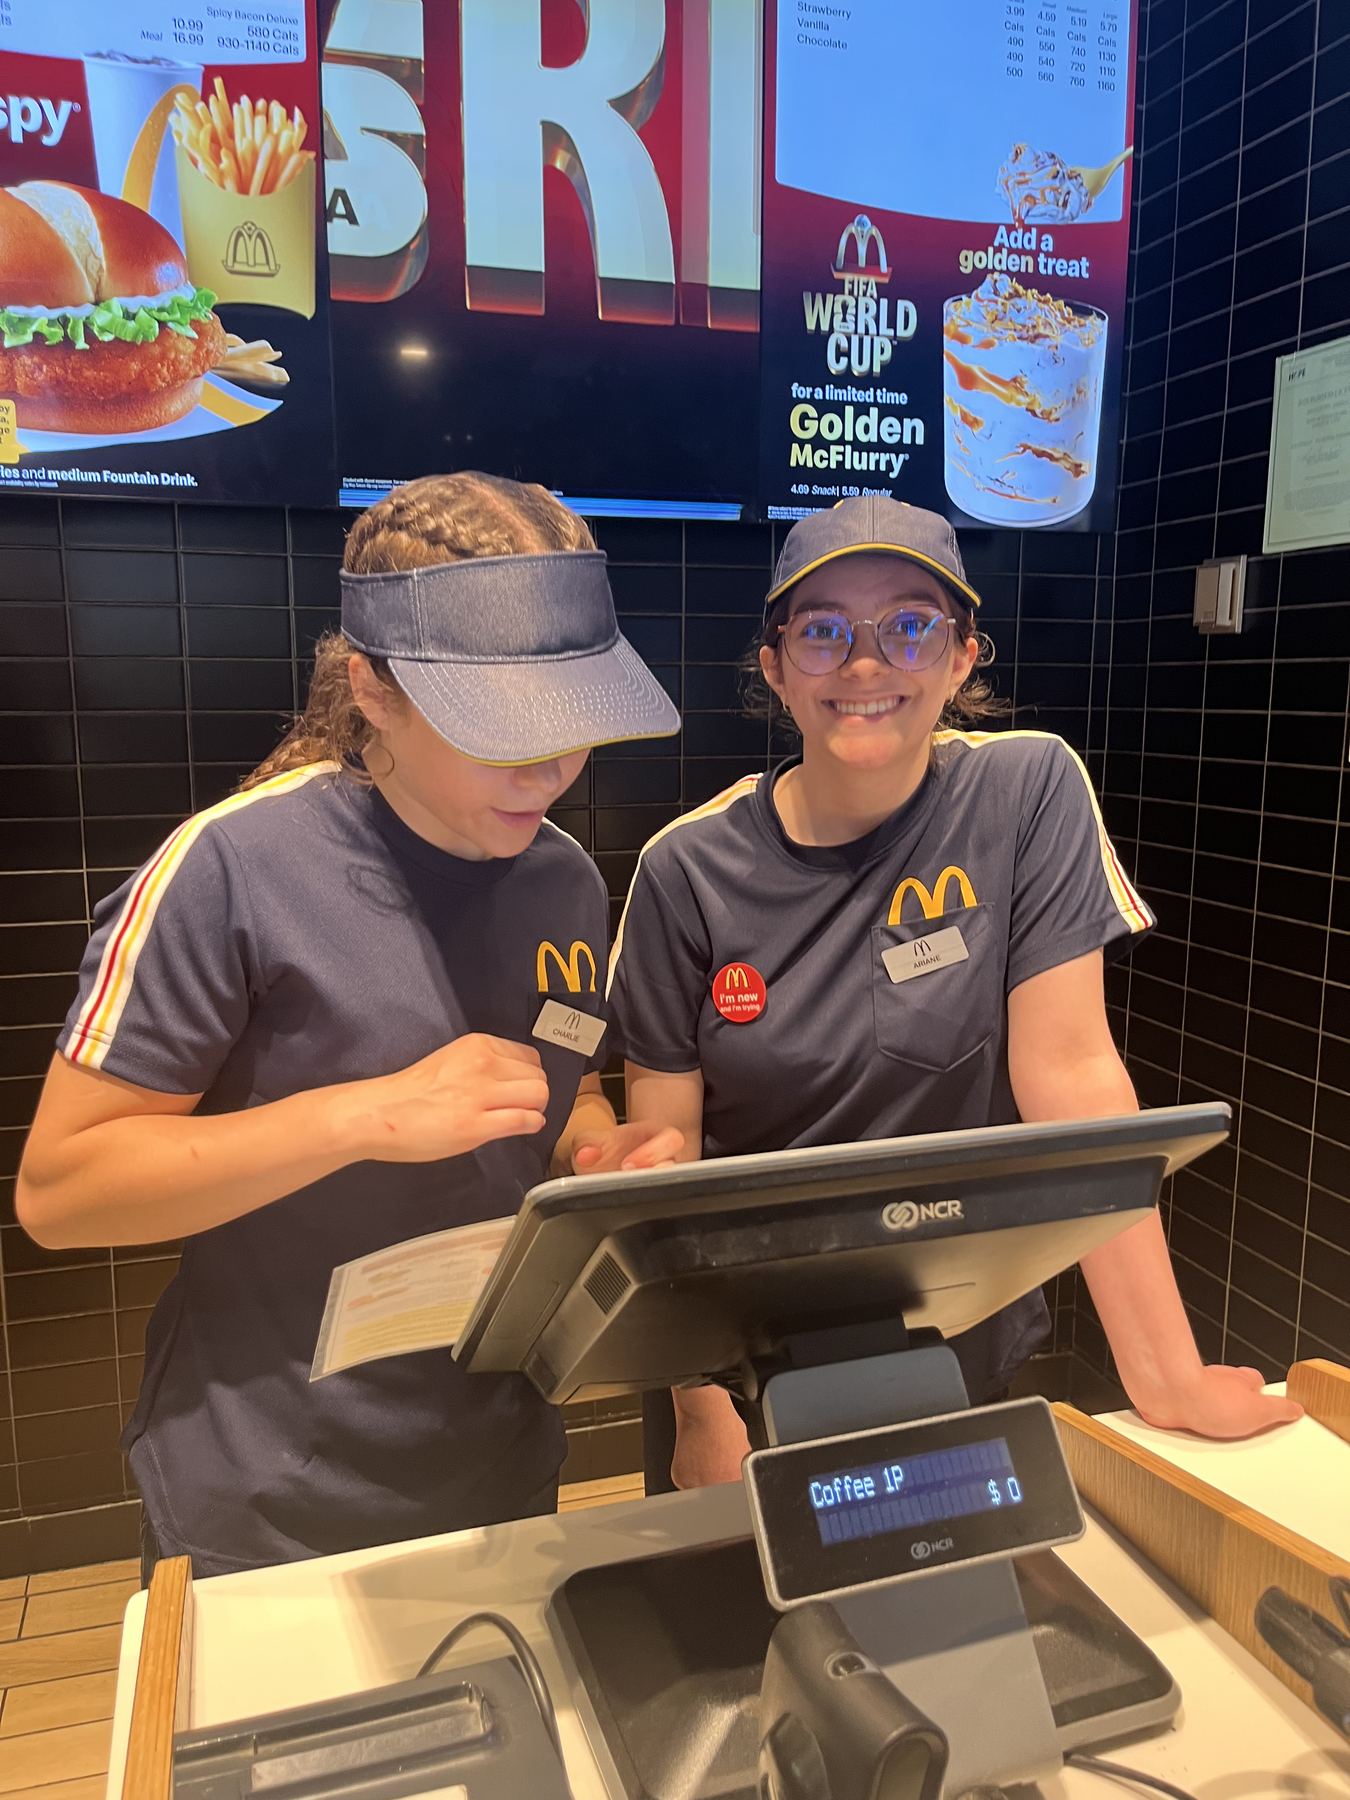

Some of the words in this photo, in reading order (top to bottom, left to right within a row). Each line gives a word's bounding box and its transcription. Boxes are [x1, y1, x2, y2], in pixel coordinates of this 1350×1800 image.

[206, 6, 232, 20] Spicy
[234, 10, 264, 21] Bacon
[266, 12, 298, 25] Deluxe
[797, 1, 851, 20] Strawberry
[172, 17, 203, 31] 10.99
[247, 25, 269, 38] 580
[272, 27, 298, 41] Cals
[797, 17, 829, 31] Vanilla
[1004, 21, 1024, 33] Cals
[1036, 26, 1056, 38] Cals
[1067, 31, 1086, 43] Cals
[1097, 36, 1117, 48] Cals
[140, 30, 162, 41] Meal
[173, 32, 204, 46] 16.99
[217, 36, 270, 51] 930-1140
[272, 41, 299, 55] Cals
[797, 33, 848, 50] Chocolate
[1071, 46, 1086, 57] 740
[1071, 61, 1086, 73] 720
[994, 225, 1036, 250] Add
[1041, 233, 1053, 252] a
[959, 247, 1033, 274] golden
[1038, 253, 1089, 278] treat
[844, 278, 878, 299] FIFA
[803, 291, 917, 340] WORLD
[827, 333, 892, 377] CUP
[791, 382, 812, 399] for
[814, 387, 823, 400] a
[826, 384, 874, 402] limited
[877, 388, 908, 405] time
[790, 403, 924, 445] Golden
[22, 467, 45, 480] and
[48, 469, 100, 482] medium
[103, 470, 158, 485] Fountain
[161, 472, 198, 487] Drink.
[790, 484, 809, 495] 4.69
[737, 993, 758, 1002] new
[552, 1028, 580, 1042] CHARLIE
[920, 1200, 962, 1221] NCR
[809, 1475, 876, 1508] Coffee
[883, 1464, 904, 1493] 1P
[931, 1538, 954, 1551] NCR
